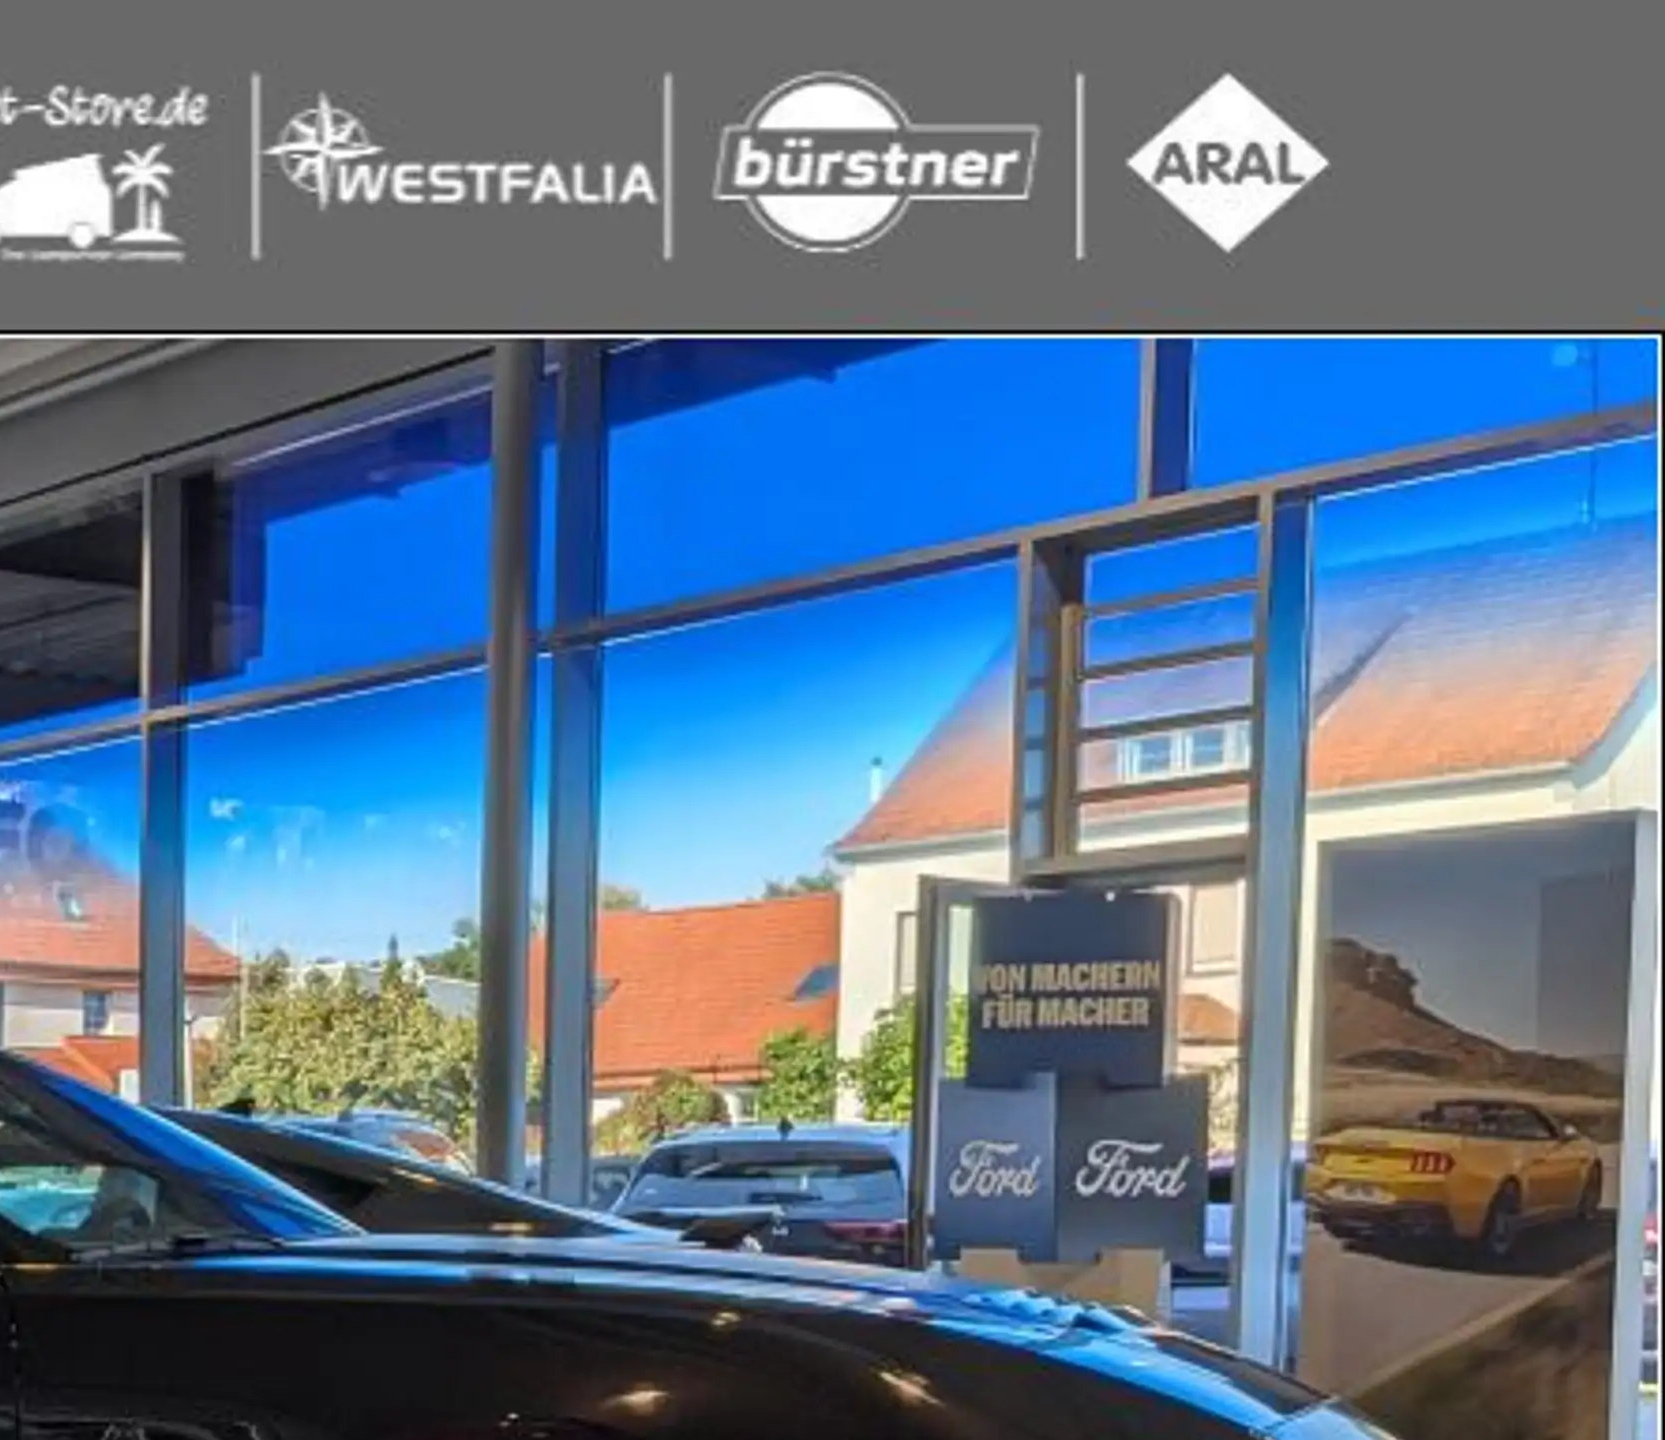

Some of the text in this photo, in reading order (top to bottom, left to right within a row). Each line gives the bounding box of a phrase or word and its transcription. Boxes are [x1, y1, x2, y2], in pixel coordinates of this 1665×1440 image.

[973, 961, 1160, 993] VON MACHERN
[981, 993, 1149, 1029] FÜR MACHER
[948, 1138, 1041, 1198] Ford
[1075, 1138, 1190, 1198] Ford
